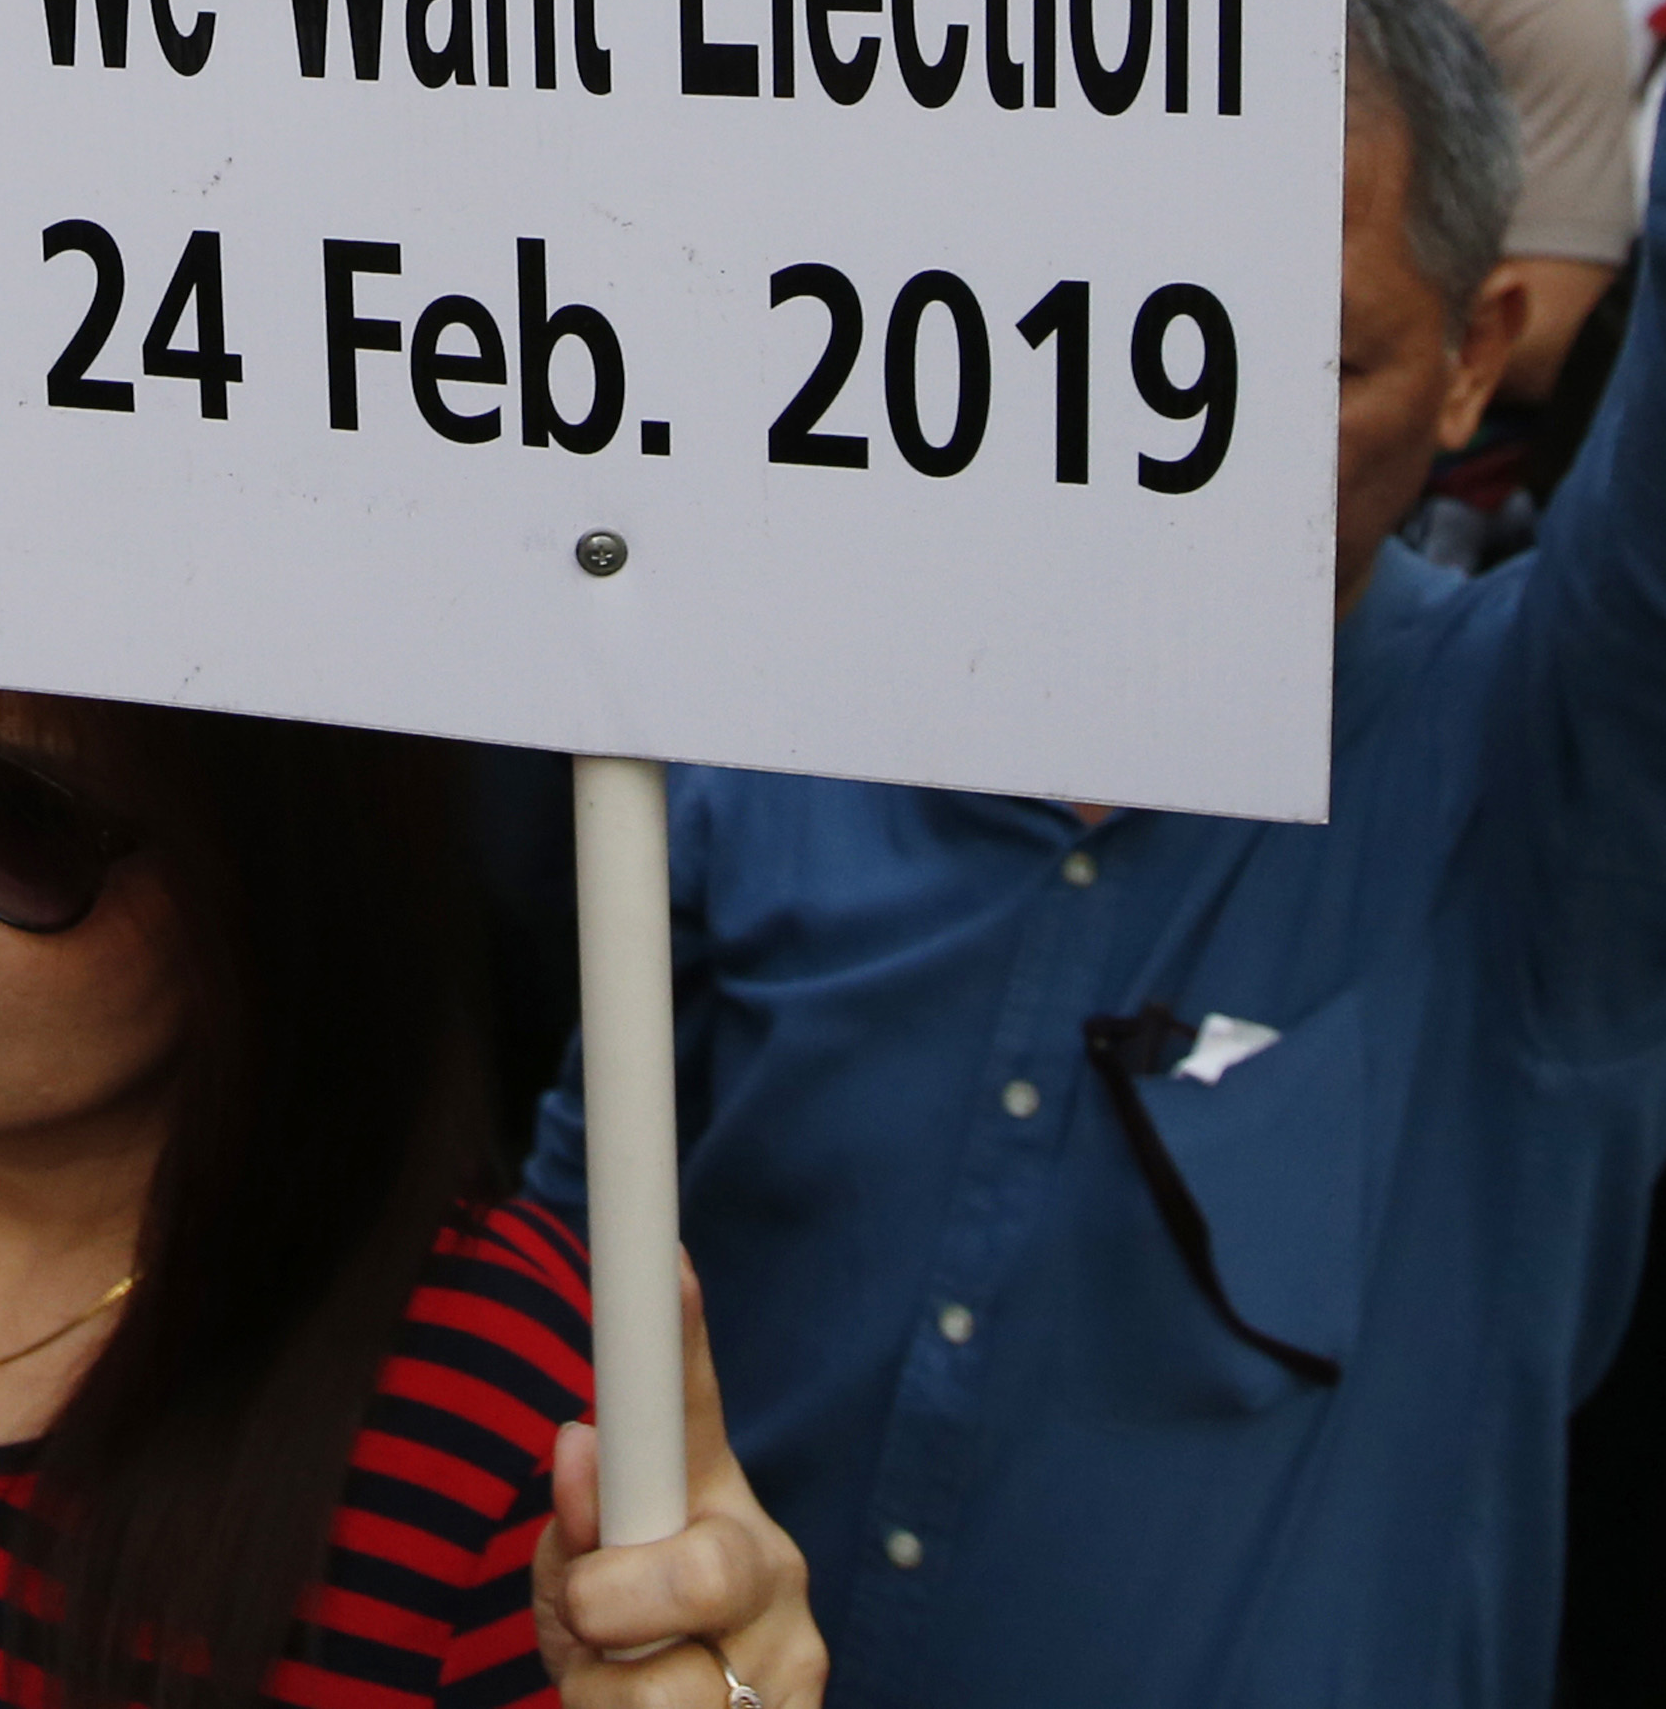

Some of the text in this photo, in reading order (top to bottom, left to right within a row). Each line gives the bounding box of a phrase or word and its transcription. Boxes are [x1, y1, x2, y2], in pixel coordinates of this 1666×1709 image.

[41, 218, 1238, 495] 24 Feb. 2019
